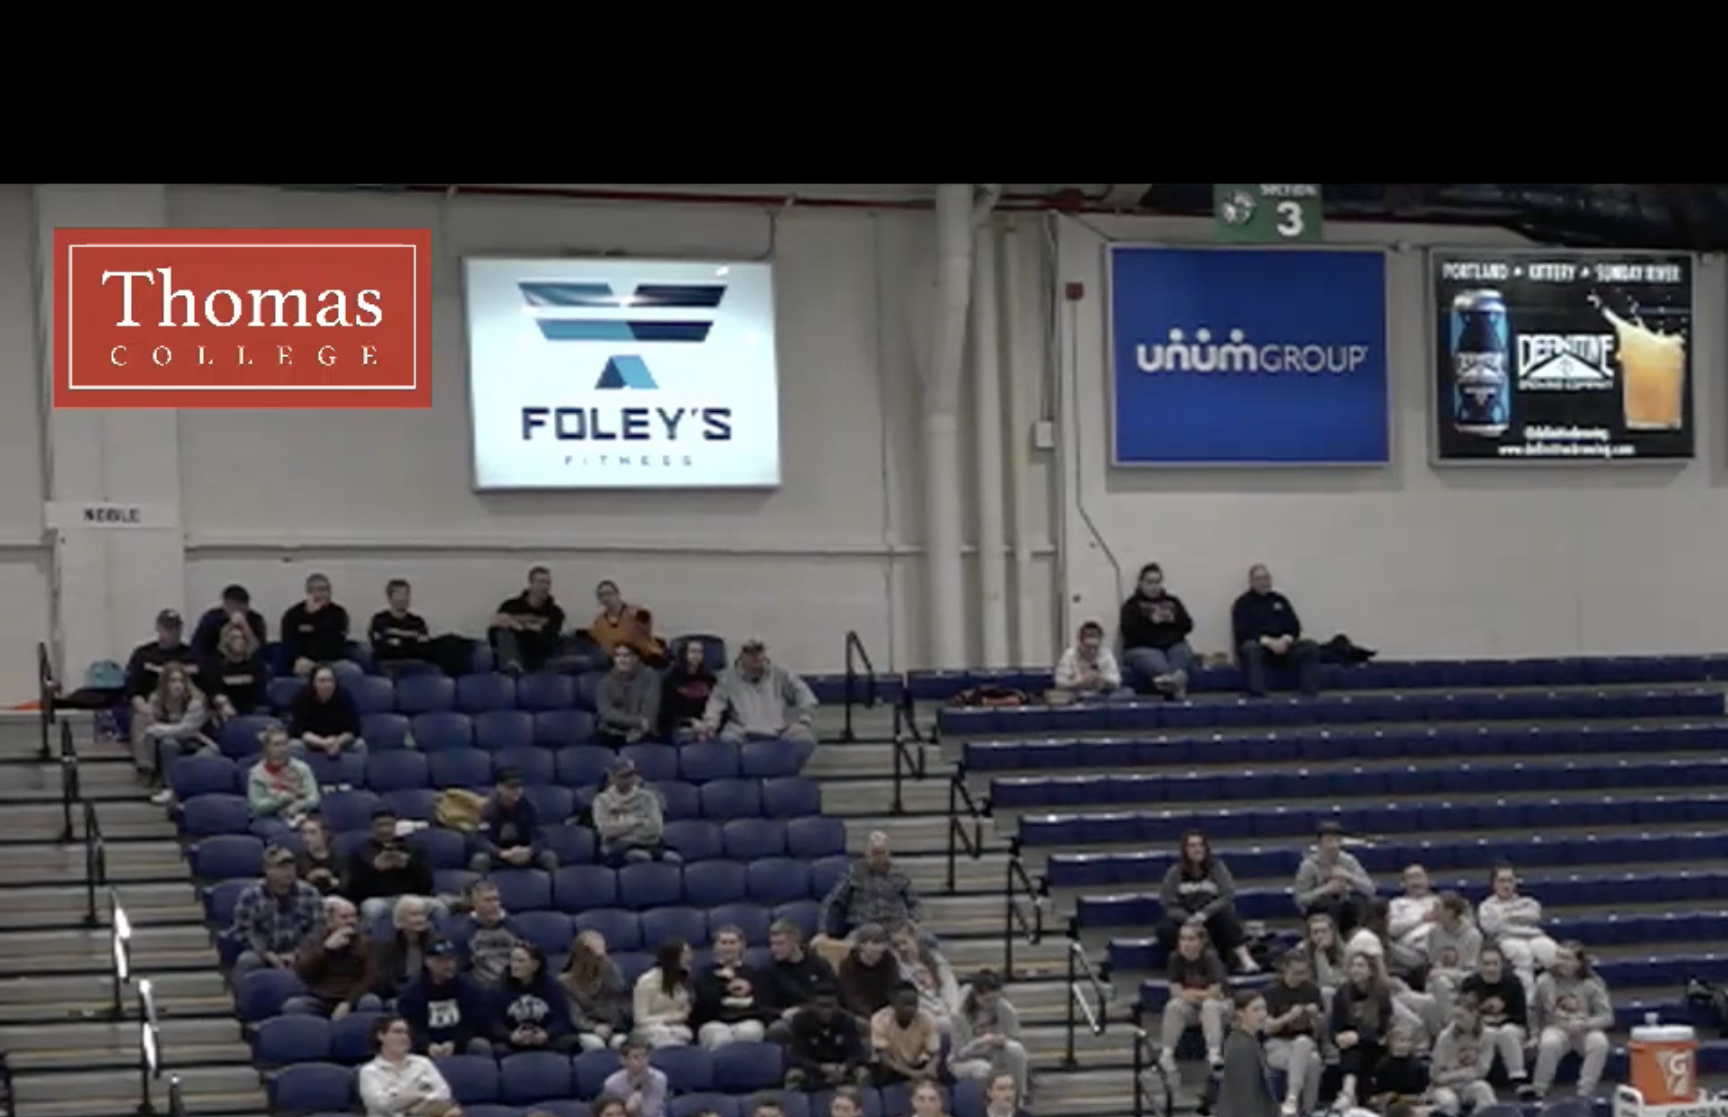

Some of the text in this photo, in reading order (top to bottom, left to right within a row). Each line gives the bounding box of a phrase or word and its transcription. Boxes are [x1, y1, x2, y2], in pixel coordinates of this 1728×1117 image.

[1276, 201, 1304, 237] 3
[1443, 262, 1508, 280] PORTLAND
[521, 406, 732, 441] FOLEY'S
